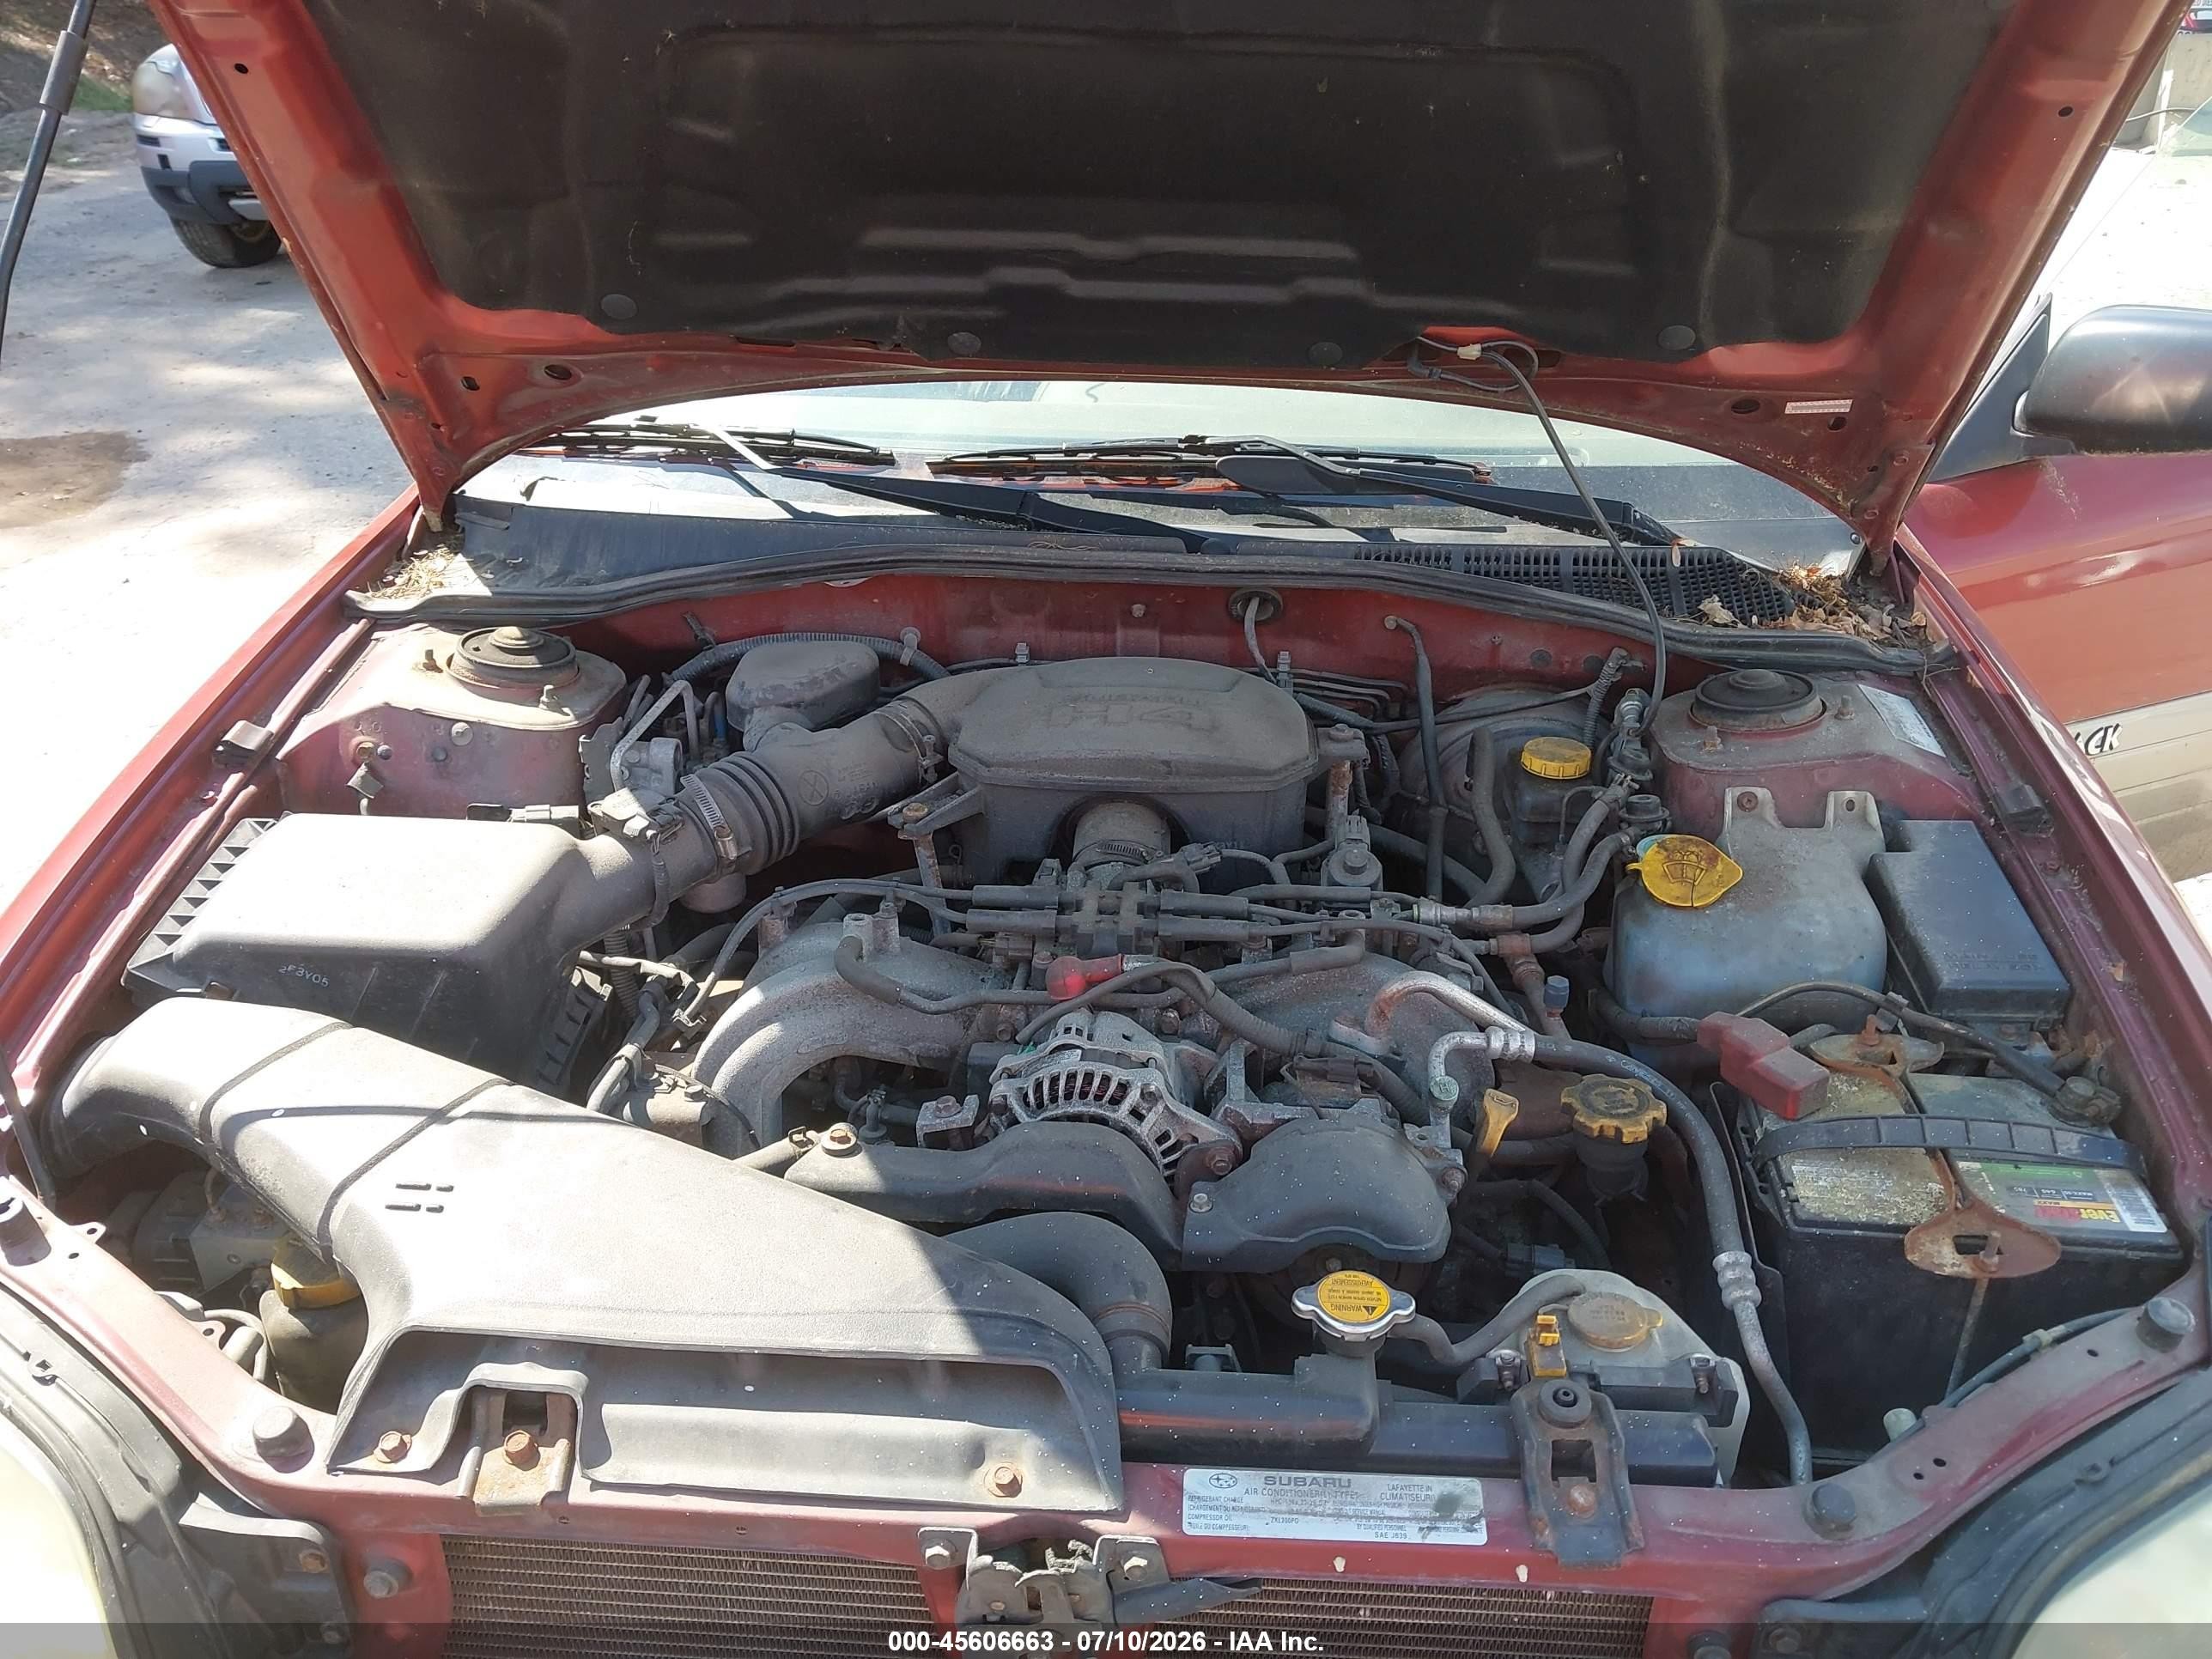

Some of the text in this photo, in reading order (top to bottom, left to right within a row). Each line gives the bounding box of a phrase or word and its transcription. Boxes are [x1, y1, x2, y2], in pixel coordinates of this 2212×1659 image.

[1330, 1304, 1363, 1313] WARNING
[1264, 1476, 1352, 1488] SUBARU
[1374, 1531, 1389, 1540] SAE
